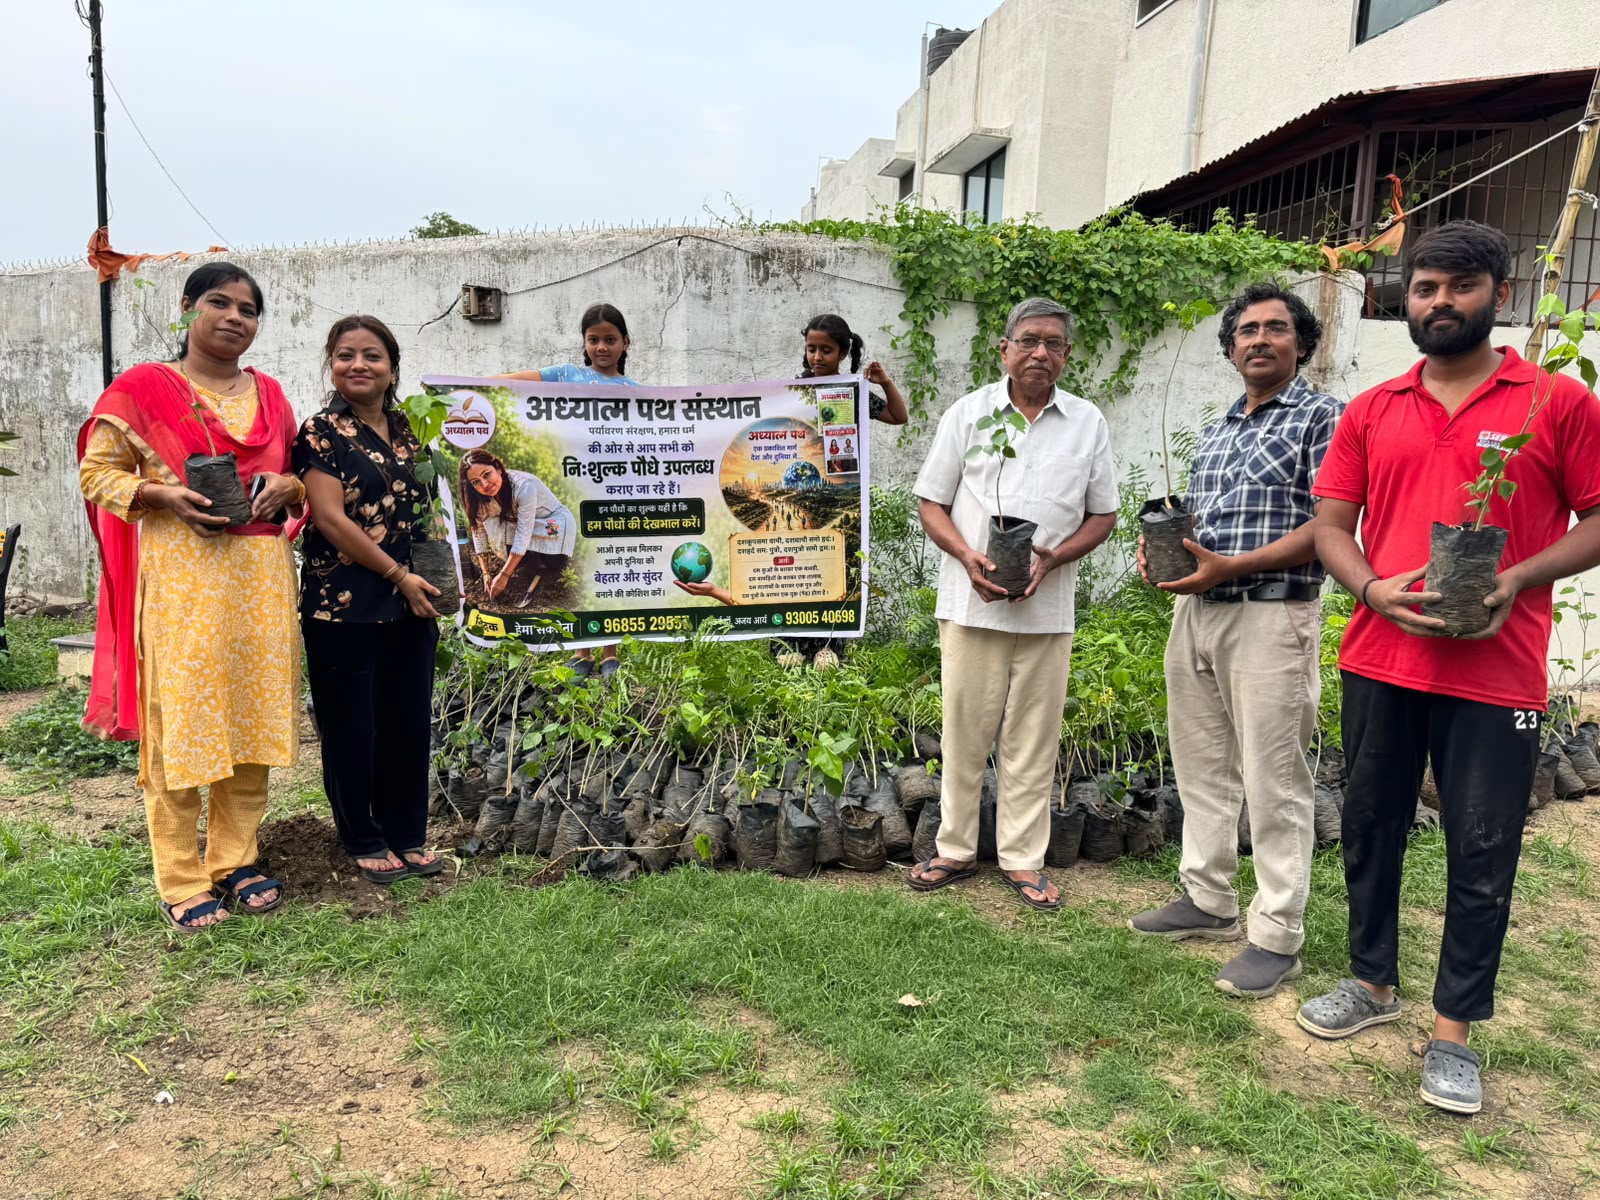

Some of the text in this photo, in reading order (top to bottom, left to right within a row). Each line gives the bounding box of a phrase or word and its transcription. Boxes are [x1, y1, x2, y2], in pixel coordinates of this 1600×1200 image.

[526, 392, 762, 421] अध्यात्म पथ संस्थान
[589, 424, 695, 436] पर्यावरण संरक्षण, हमारा धर्म
[748, 430, 806, 440] अध्यात्म पथ
[588, 440, 694, 454] की ओर से आप सभी को
[774, 453, 791, 462] दुनिया
[562, 456, 715, 483] निःशुल्क पौधे उपलब्ध
[606, 481, 680, 495] कराए जा रहे हैं।
[599, 506, 608, 514] इन
[610, 504, 626, 512] पौधों
[639, 505, 656, 514] शुल्क
[672, 502, 677, 512] है
[678, 502, 688, 511] कि
[587, 520, 602, 532] हम
[604, 517, 626, 530] पौधों
[628, 517, 640, 530] की
[643, 517, 679, 530] देखभाल
[596, 545, 613, 553] आओ
[639, 544, 663, 552] मिलकर
[604, 556, 654, 567] अपनी दुनिया को
[594, 569, 663, 585] बेहतर और सुंदर
[595, 589, 613, 598] बनाने
[615, 589, 624, 597] की
[626, 588, 649, 597] कोशिश
[753, 614, 767, 624] आर्य
[786, 610, 854, 625] 93005 40698
[514, 622, 533, 636] हेमा
[604, 617, 646, 633] 96855
[1514, 711, 1537, 729] 23
